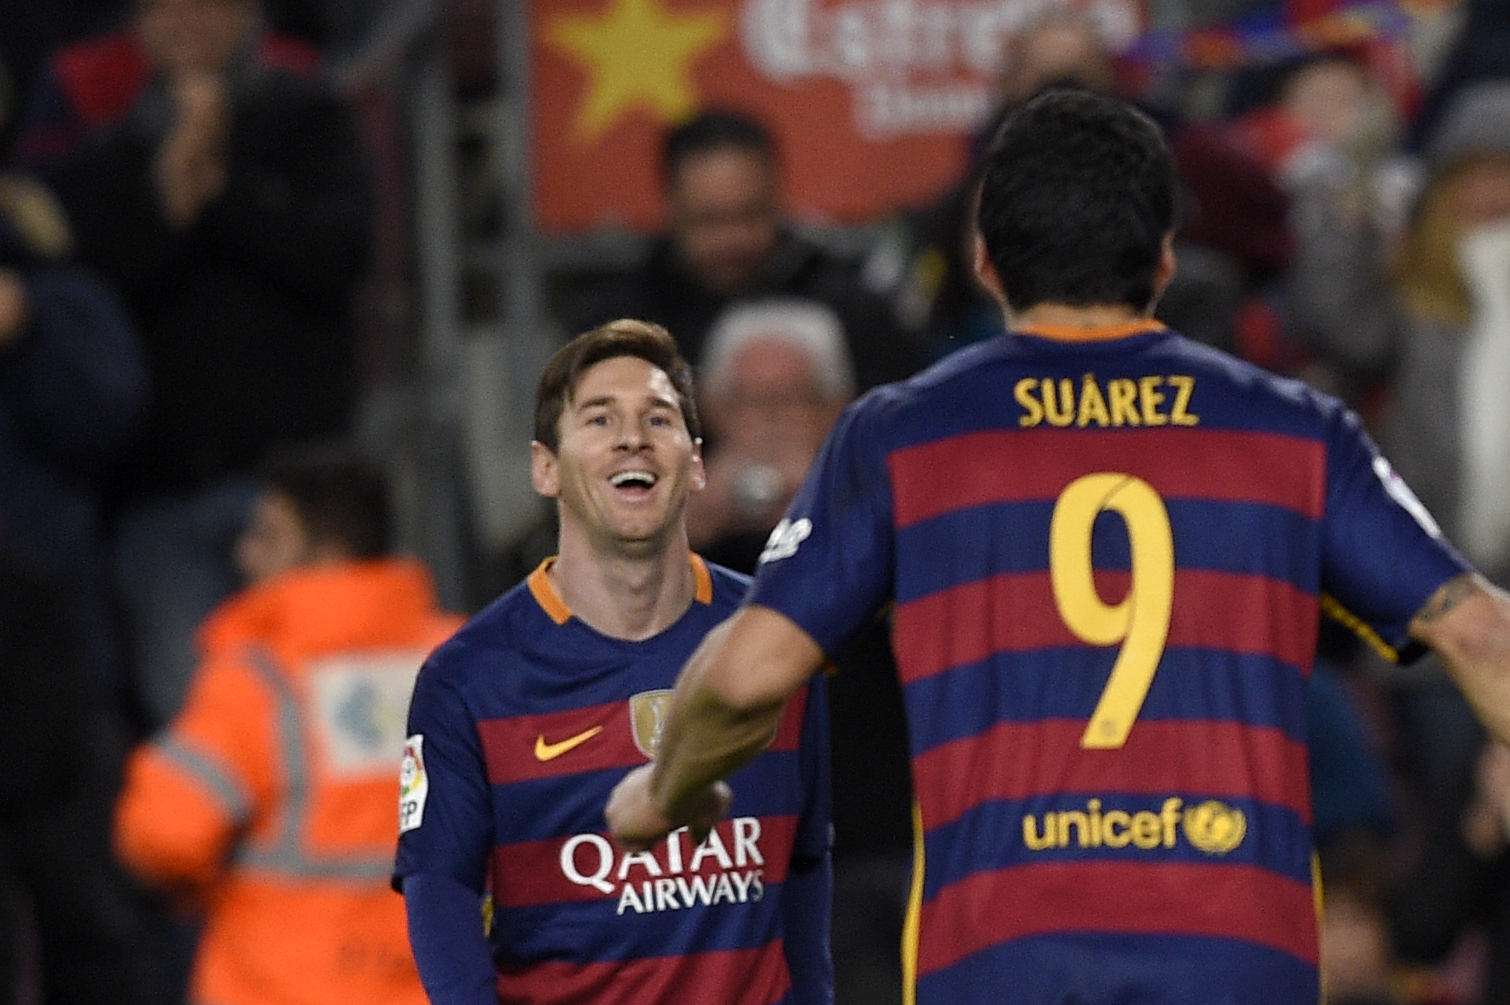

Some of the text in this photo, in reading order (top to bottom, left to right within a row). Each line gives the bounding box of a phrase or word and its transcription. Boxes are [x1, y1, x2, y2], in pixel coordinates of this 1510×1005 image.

[1013, 371, 1200, 428] SUÁREZ
[1048, 471, 1176, 750] 9
[1021, 796, 1183, 851] unicef
[615, 869, 765, 916] AIRWAYS
